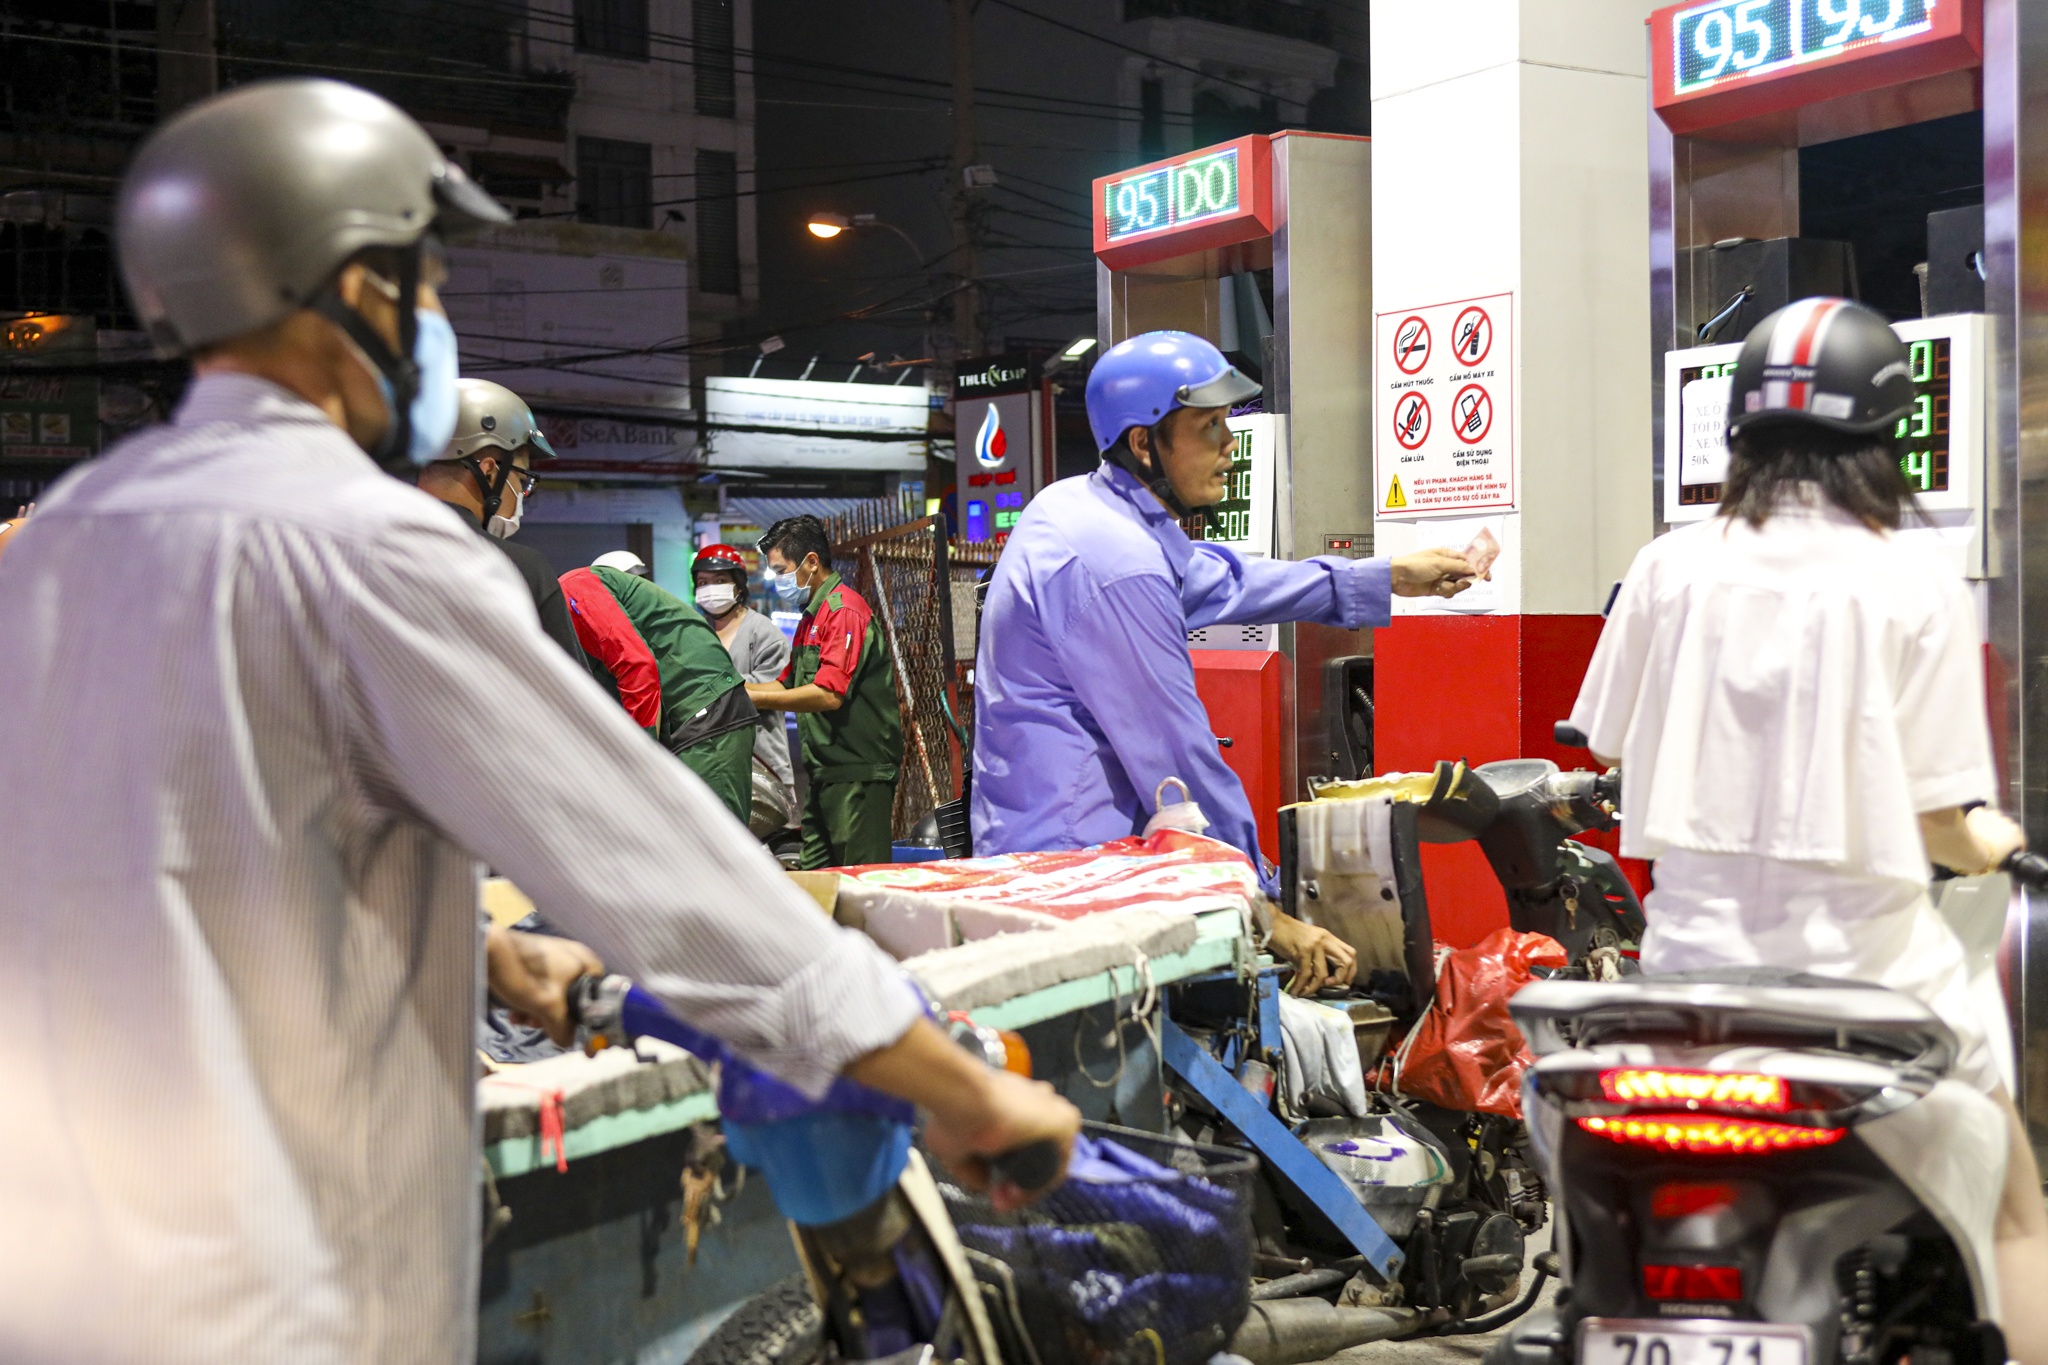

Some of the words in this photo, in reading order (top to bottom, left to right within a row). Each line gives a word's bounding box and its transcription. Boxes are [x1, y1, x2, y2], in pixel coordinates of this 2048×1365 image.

[1694, 1, 1772, 79] 95
[1117, 178, 1158, 231] 95
[1178, 160, 1231, 218] DO
[1450, 372, 1461, 381] CẤM
[1391, 381, 1402, 389] CẤM
[1415, 377, 1434, 386] THUỐC
[580, 422, 678, 445] SeABank
[1401, 455, 1412, 463] CẤM
[1414, 453, 1424, 461] LỬA
[1453, 450, 1465, 458] CẤM
[1692, 454, 1710, 466] 50K
[1449, 475, 1468, 483] KHÁCH
[994, 491, 1023, 509] 95
